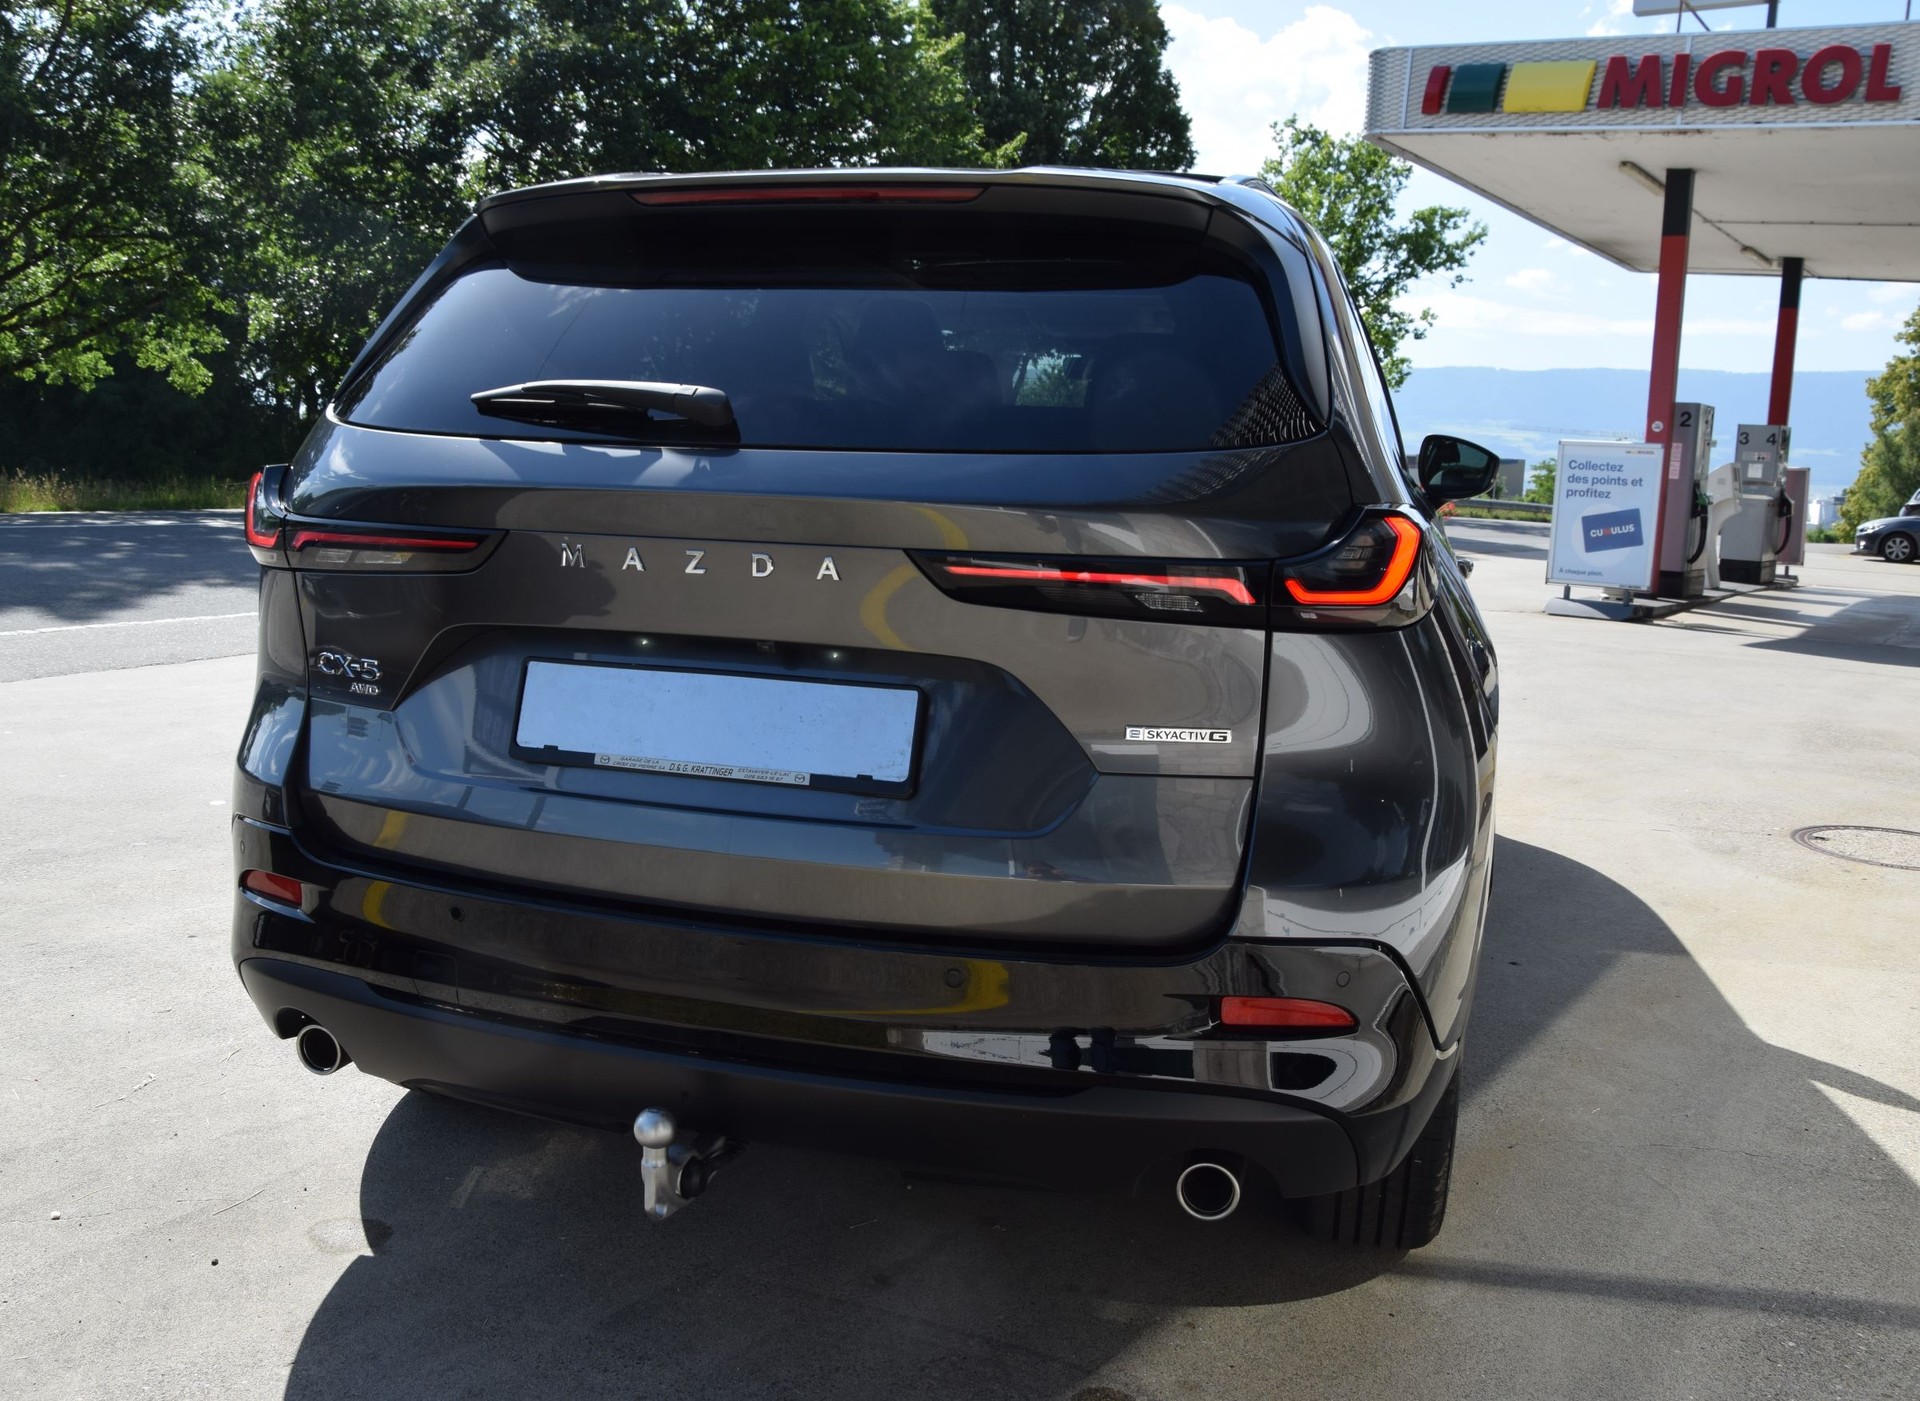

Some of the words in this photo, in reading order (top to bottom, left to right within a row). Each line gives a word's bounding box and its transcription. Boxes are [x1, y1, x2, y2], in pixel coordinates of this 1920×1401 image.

[1596, 43, 1901, 109] MIGROL
[1680, 411, 1692, 427] 2
[1739, 432, 1749, 445] 3
[1766, 433, 1777, 445] 4
[1568, 460, 1624, 472] Collectez
[1567, 474, 1588, 484] des
[1591, 475, 1628, 487] points
[1631, 477, 1643, 487] et
[1566, 488, 1611, 499] profitez
[561, 543, 842, 581] MAZDA
[318, 651, 382, 681] CX-5
[349, 682, 379, 695] AWD
[690, 765, 734, 776] KRATTINGER
